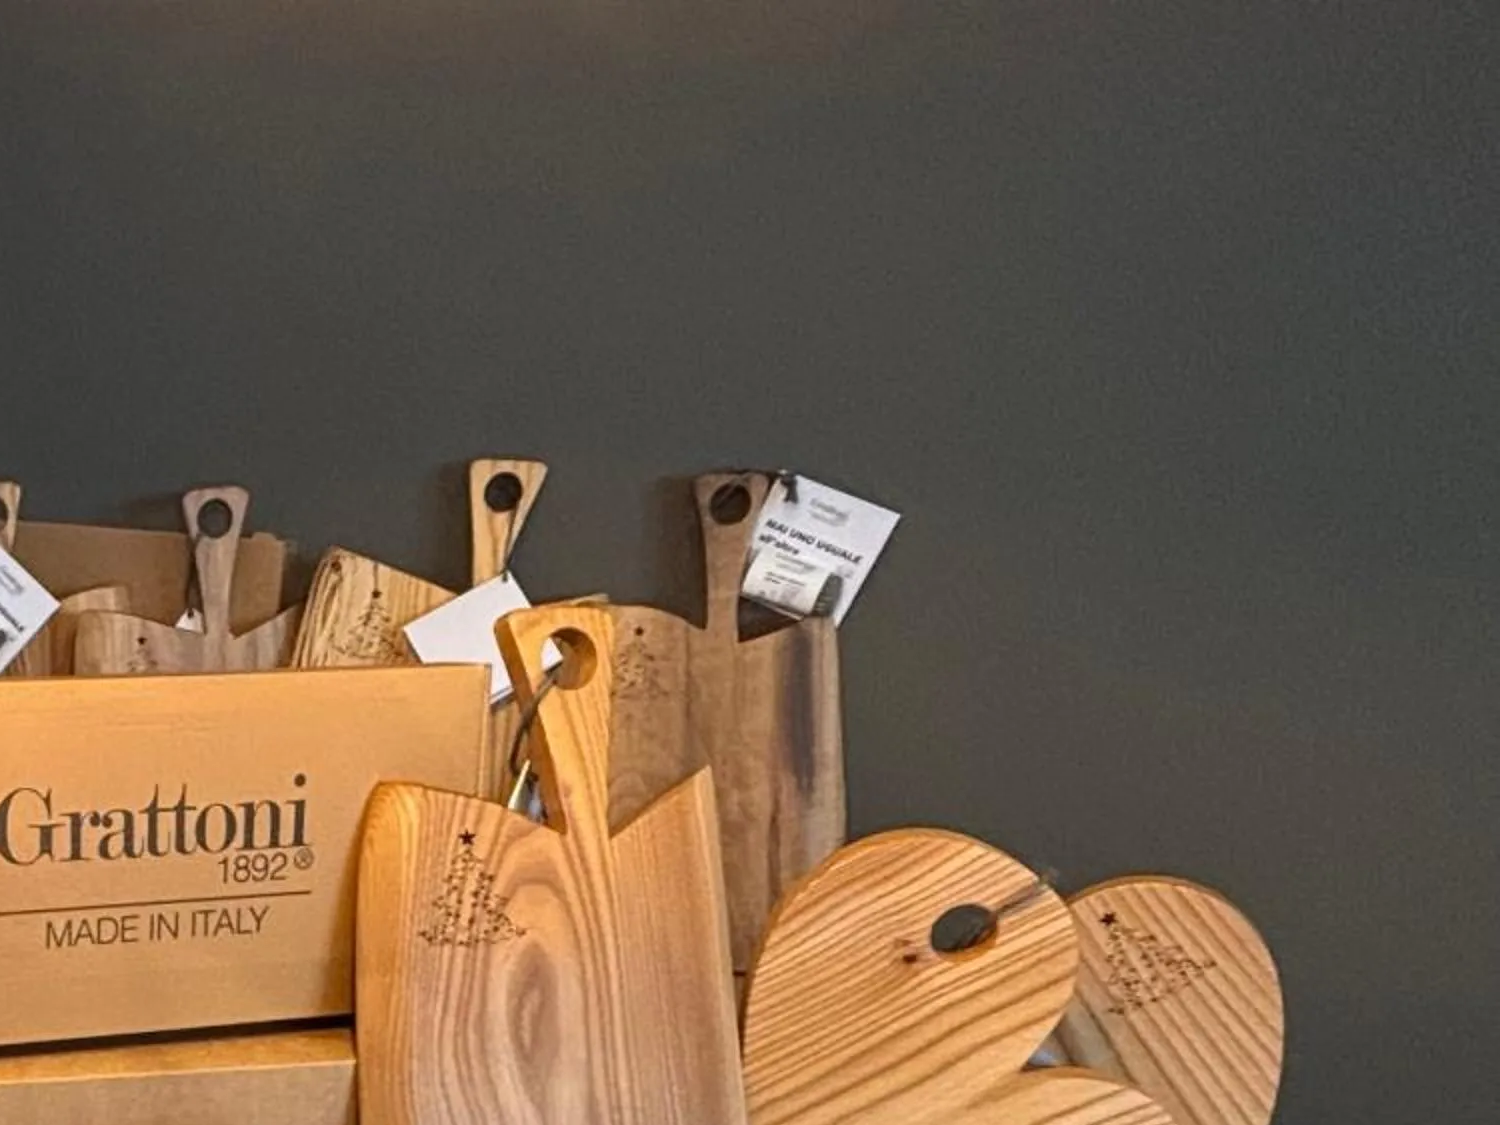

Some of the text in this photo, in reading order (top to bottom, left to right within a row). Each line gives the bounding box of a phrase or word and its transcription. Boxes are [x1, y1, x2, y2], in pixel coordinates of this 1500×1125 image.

[45, 906, 270, 949] MADE IN ITALY
